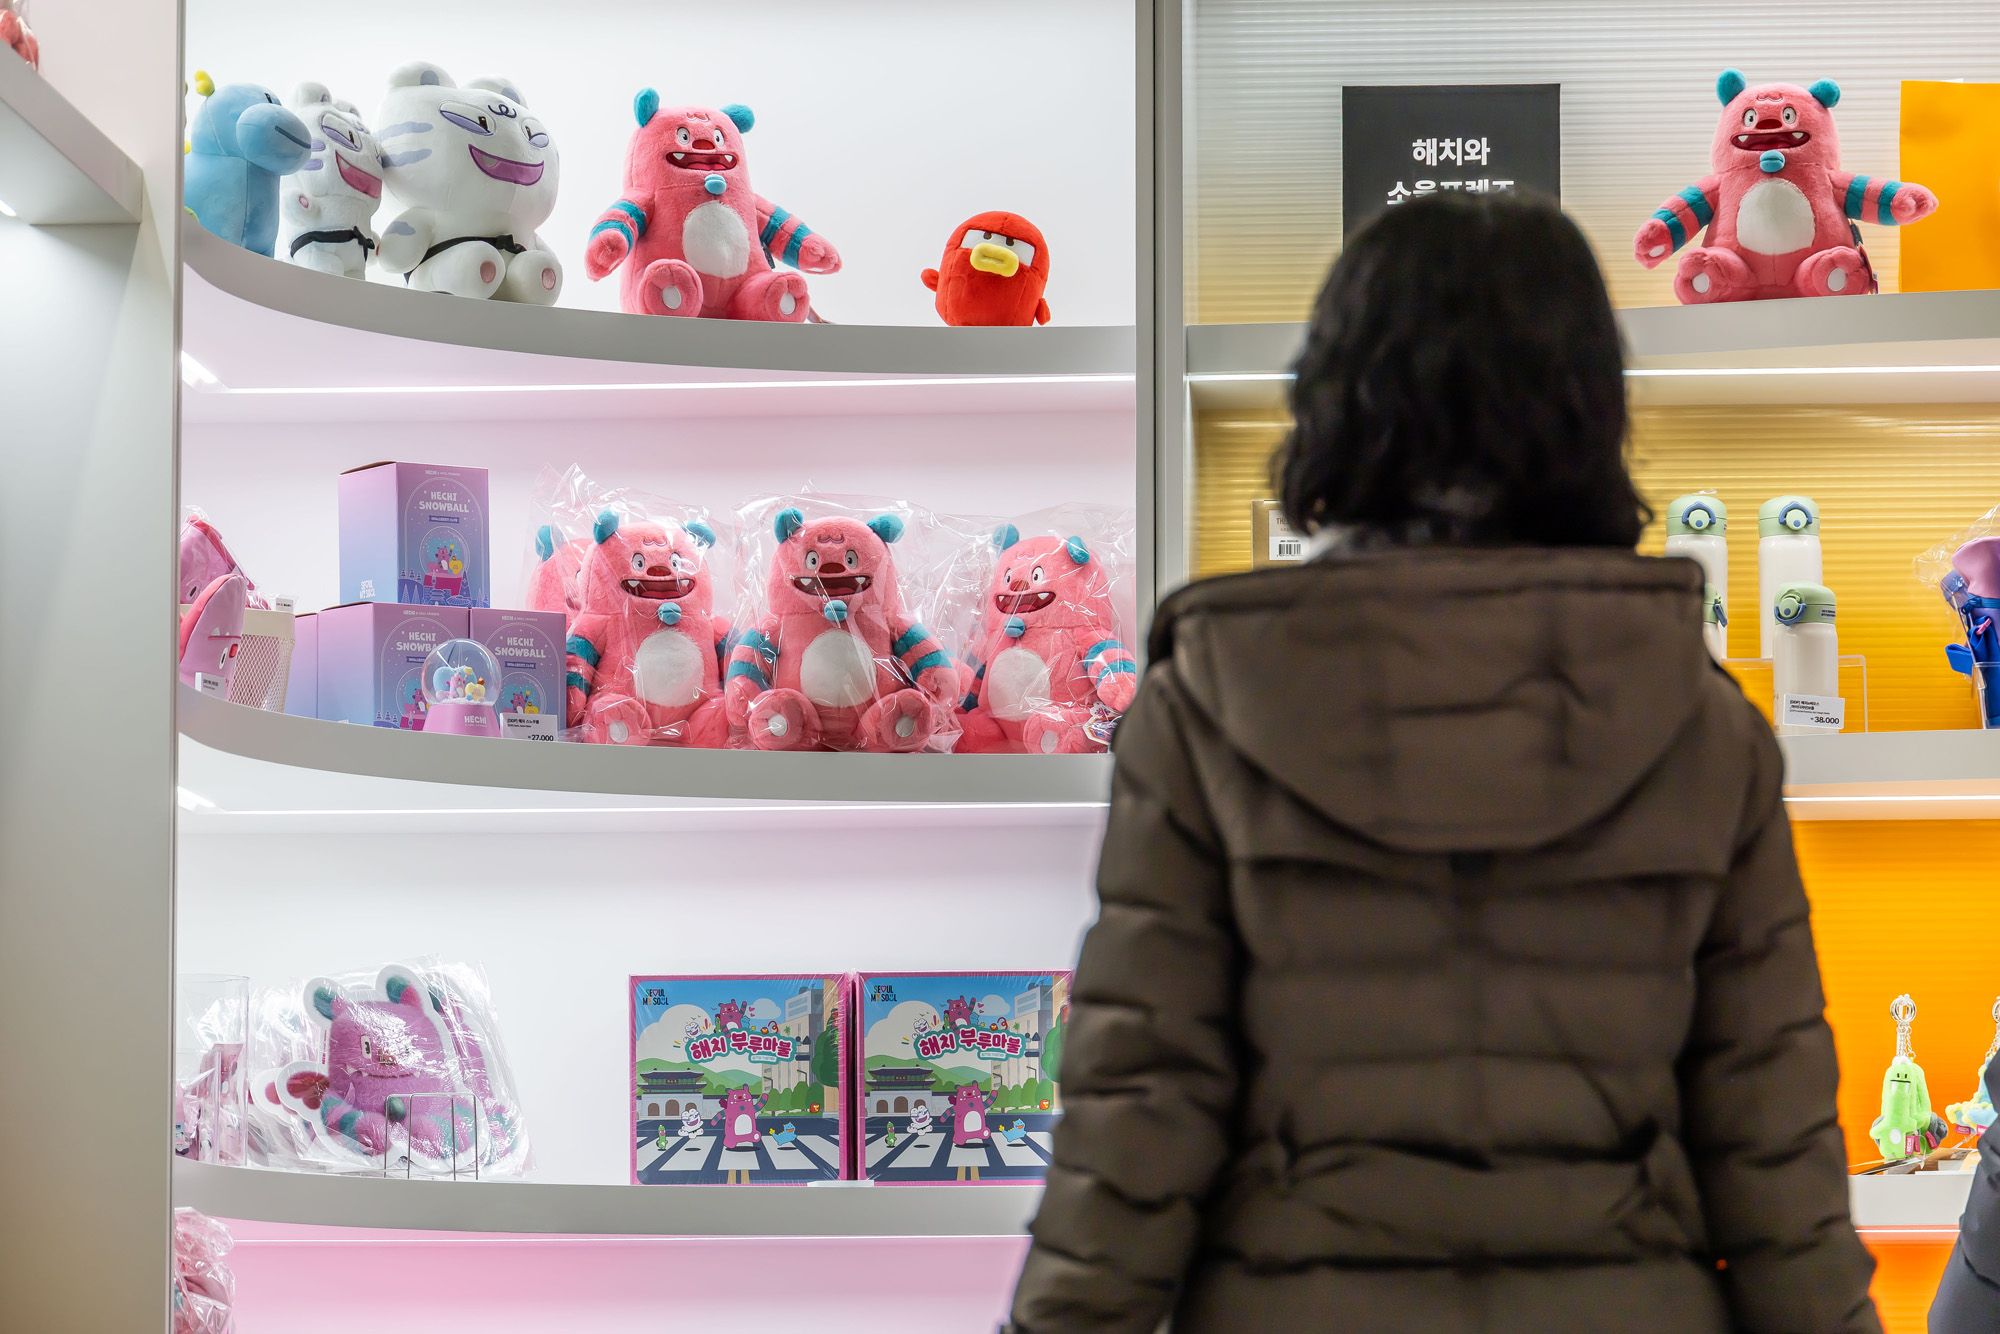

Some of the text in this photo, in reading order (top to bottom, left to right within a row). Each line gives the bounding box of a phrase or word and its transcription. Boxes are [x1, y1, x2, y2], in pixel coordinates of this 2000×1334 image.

[1412, 137, 1491, 166] 해치와
[430, 491, 457, 502] HECHI
[418, 500, 470, 513] SNOWBALL
[408, 631, 437, 642] HECHI
[507, 636, 534, 647] HECHI
[396, 641, 439, 652] SNOWBA
[494, 646, 546, 659] SNOWBALL
[464, 715, 487, 725] HECHI
[690, 1032, 792, 1060] 해치 부루마불
[919, 1028, 1021, 1056] 해치 부루마불
